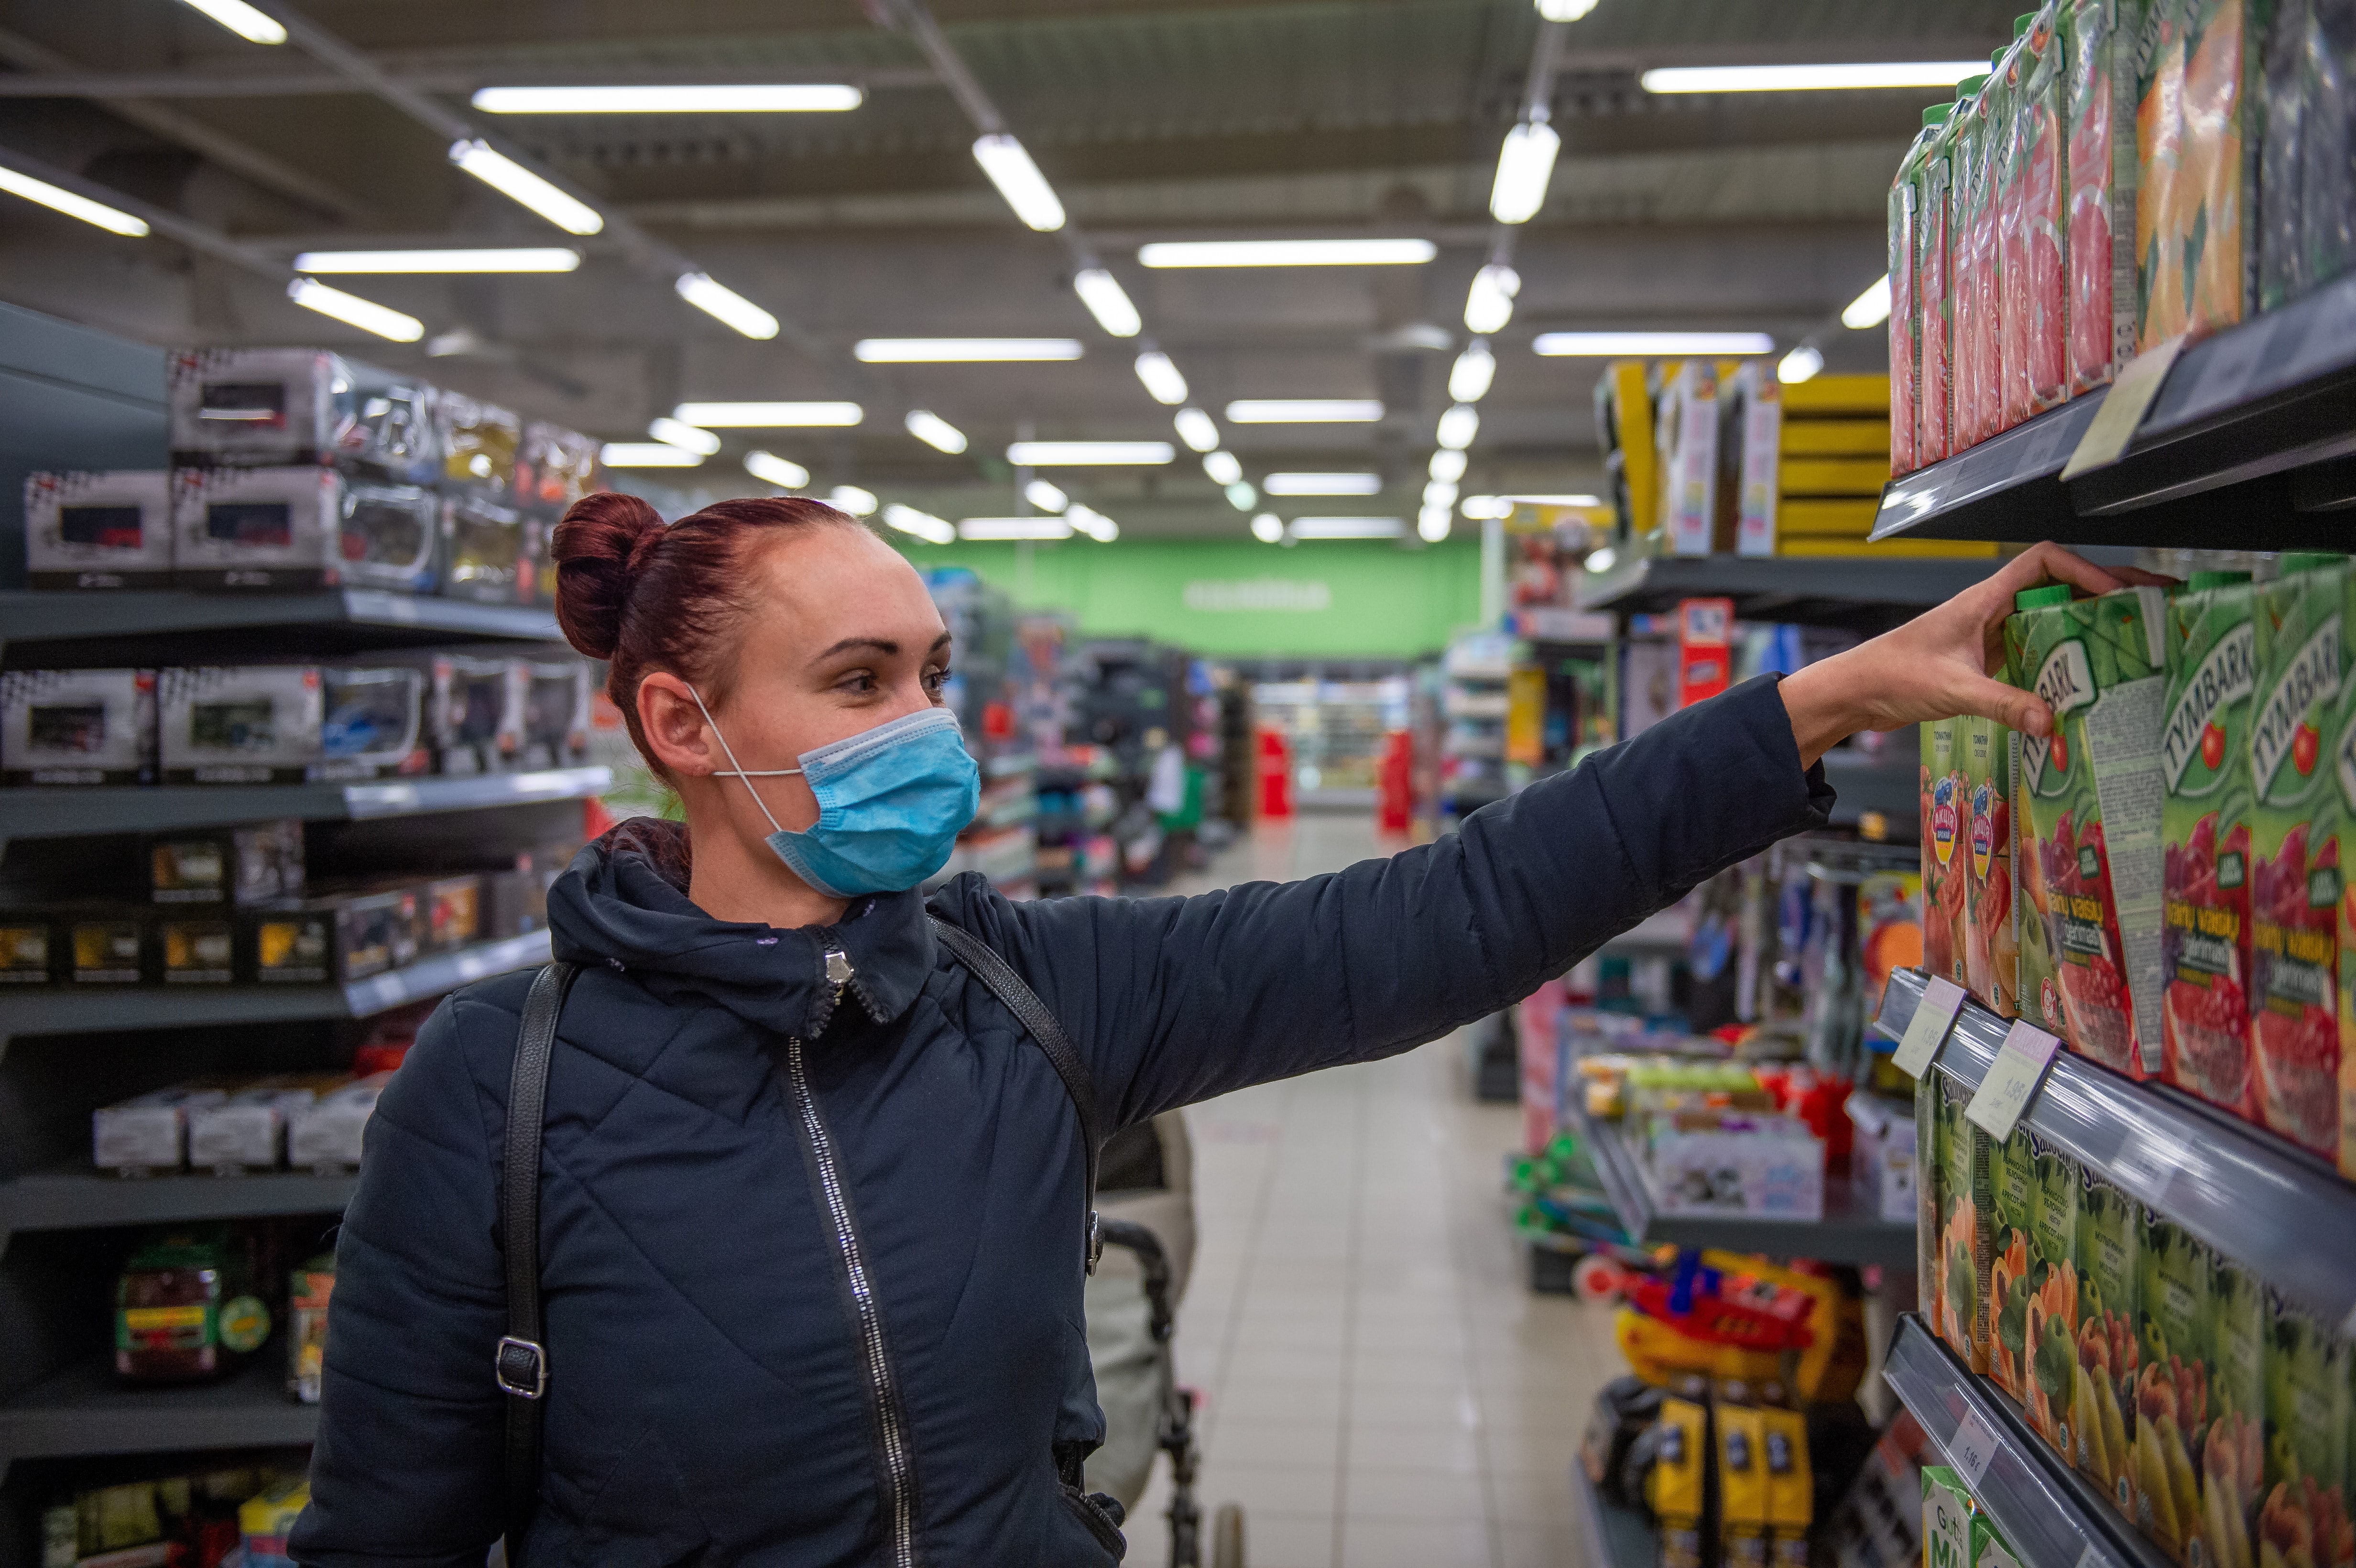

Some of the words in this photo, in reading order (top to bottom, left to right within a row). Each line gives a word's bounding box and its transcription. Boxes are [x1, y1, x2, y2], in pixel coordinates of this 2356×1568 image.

[2023, 653, 2081, 774] TYBARK
[2253, 632, 2337, 777] TYMBAR
[1935, 809, 1953, 829] АКЦІЯ
[1974, 819, 1989, 841] АКЦІЯ
[2006, 1167, 2027, 1186] ЯБЛОЧНЫ
[2002, 1188, 2027, 1209] APRICOT-APP
